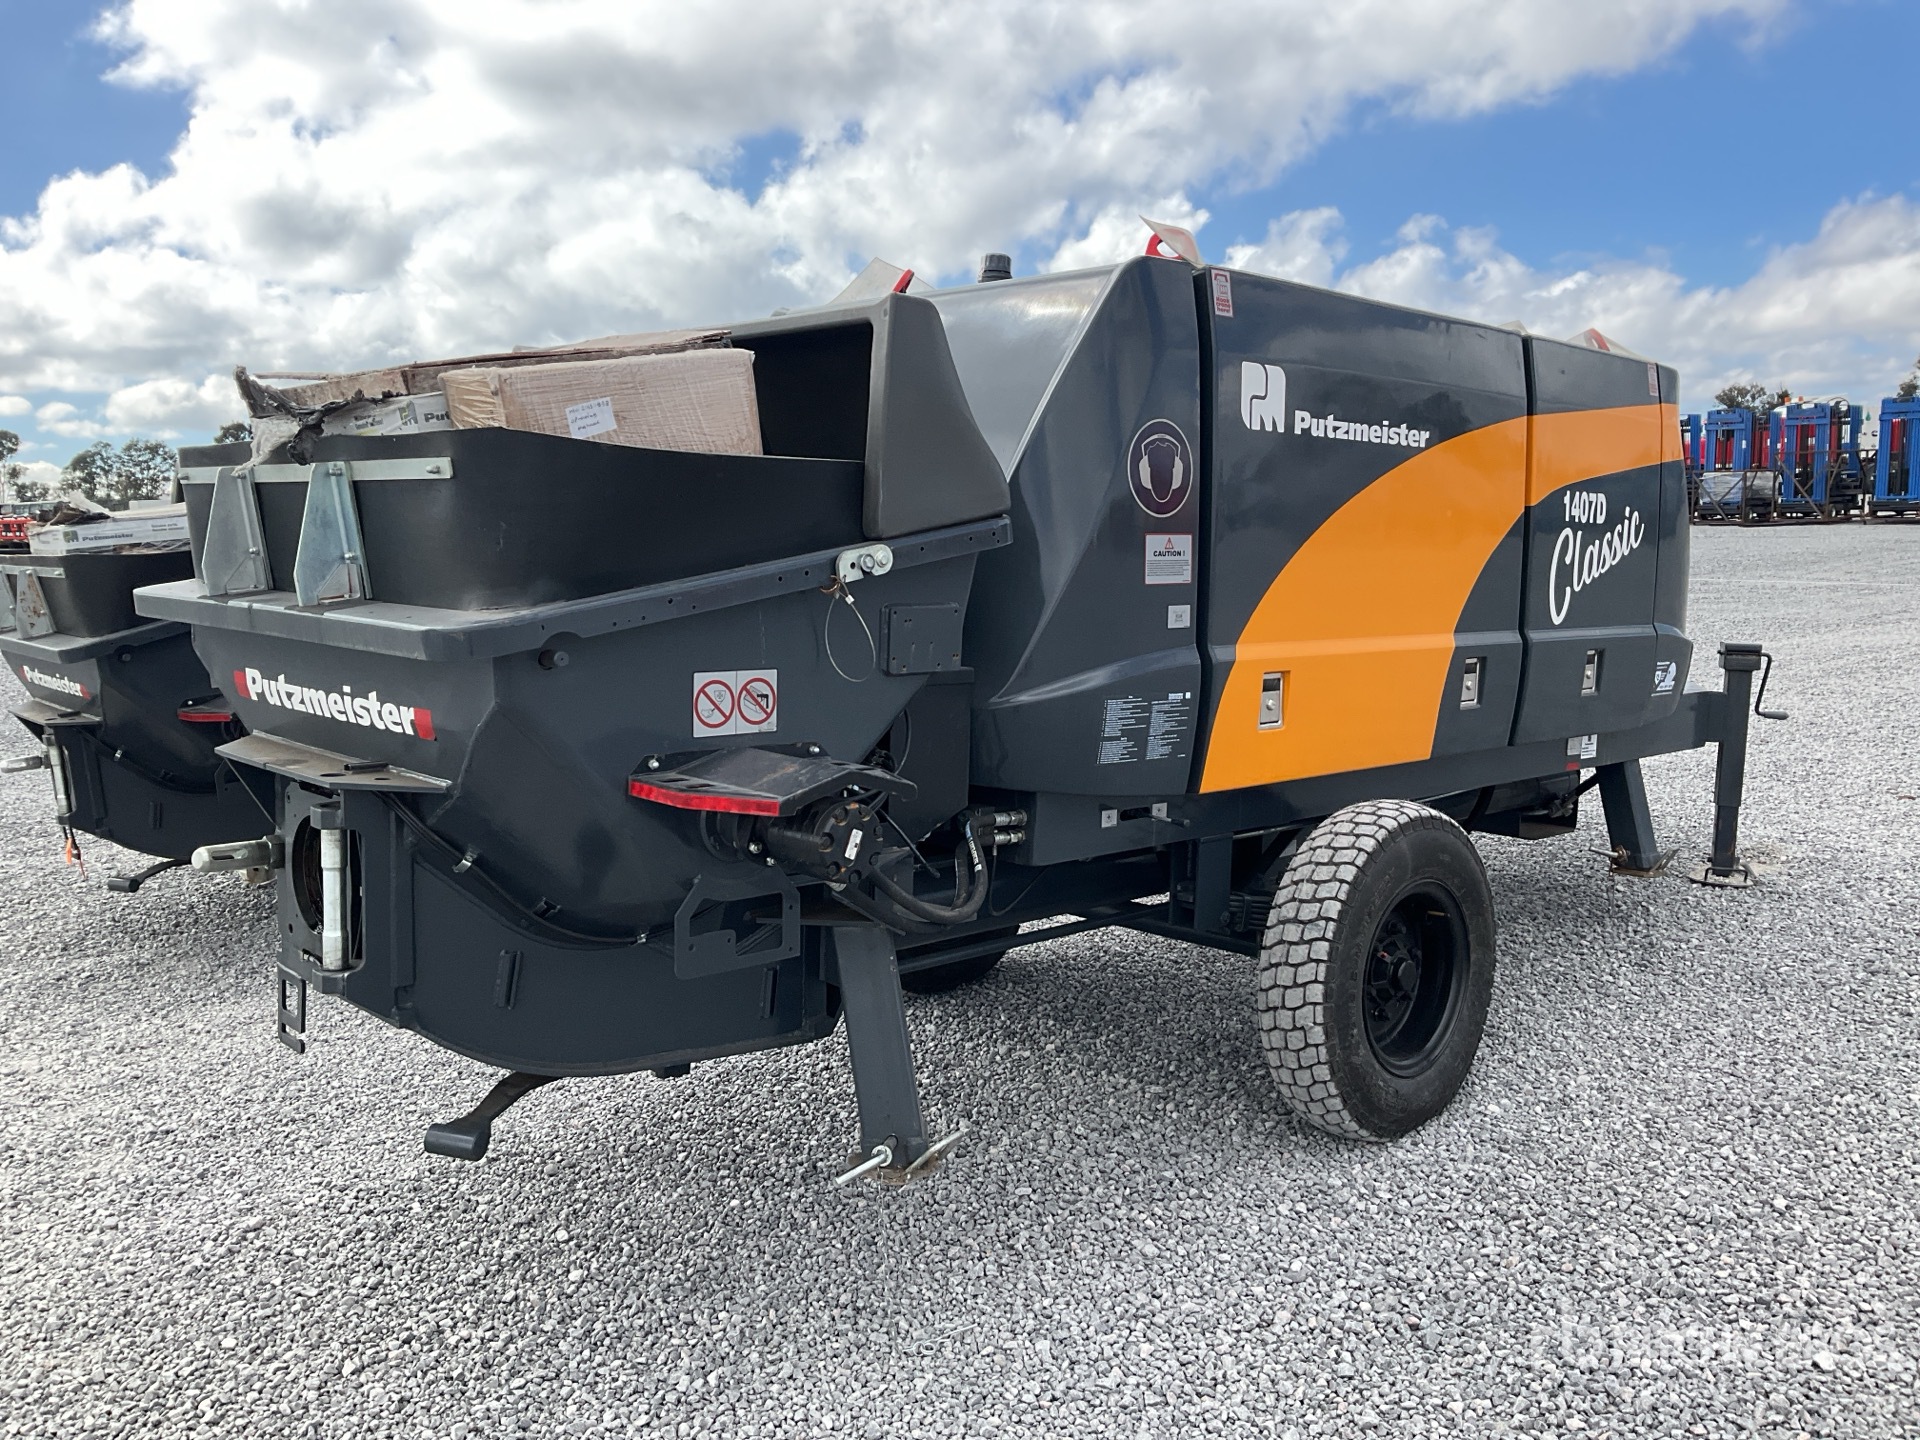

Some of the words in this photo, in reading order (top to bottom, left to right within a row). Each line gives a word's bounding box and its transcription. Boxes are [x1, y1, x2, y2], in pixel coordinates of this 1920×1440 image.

[1293, 409, 1430, 448] Putzmeister
[1563, 489, 1607, 525] 1407D
[1549, 505, 1645, 626] Classic
[22, 665, 84, 697] Putzmeister
[244, 667, 416, 736] Putzmeister
